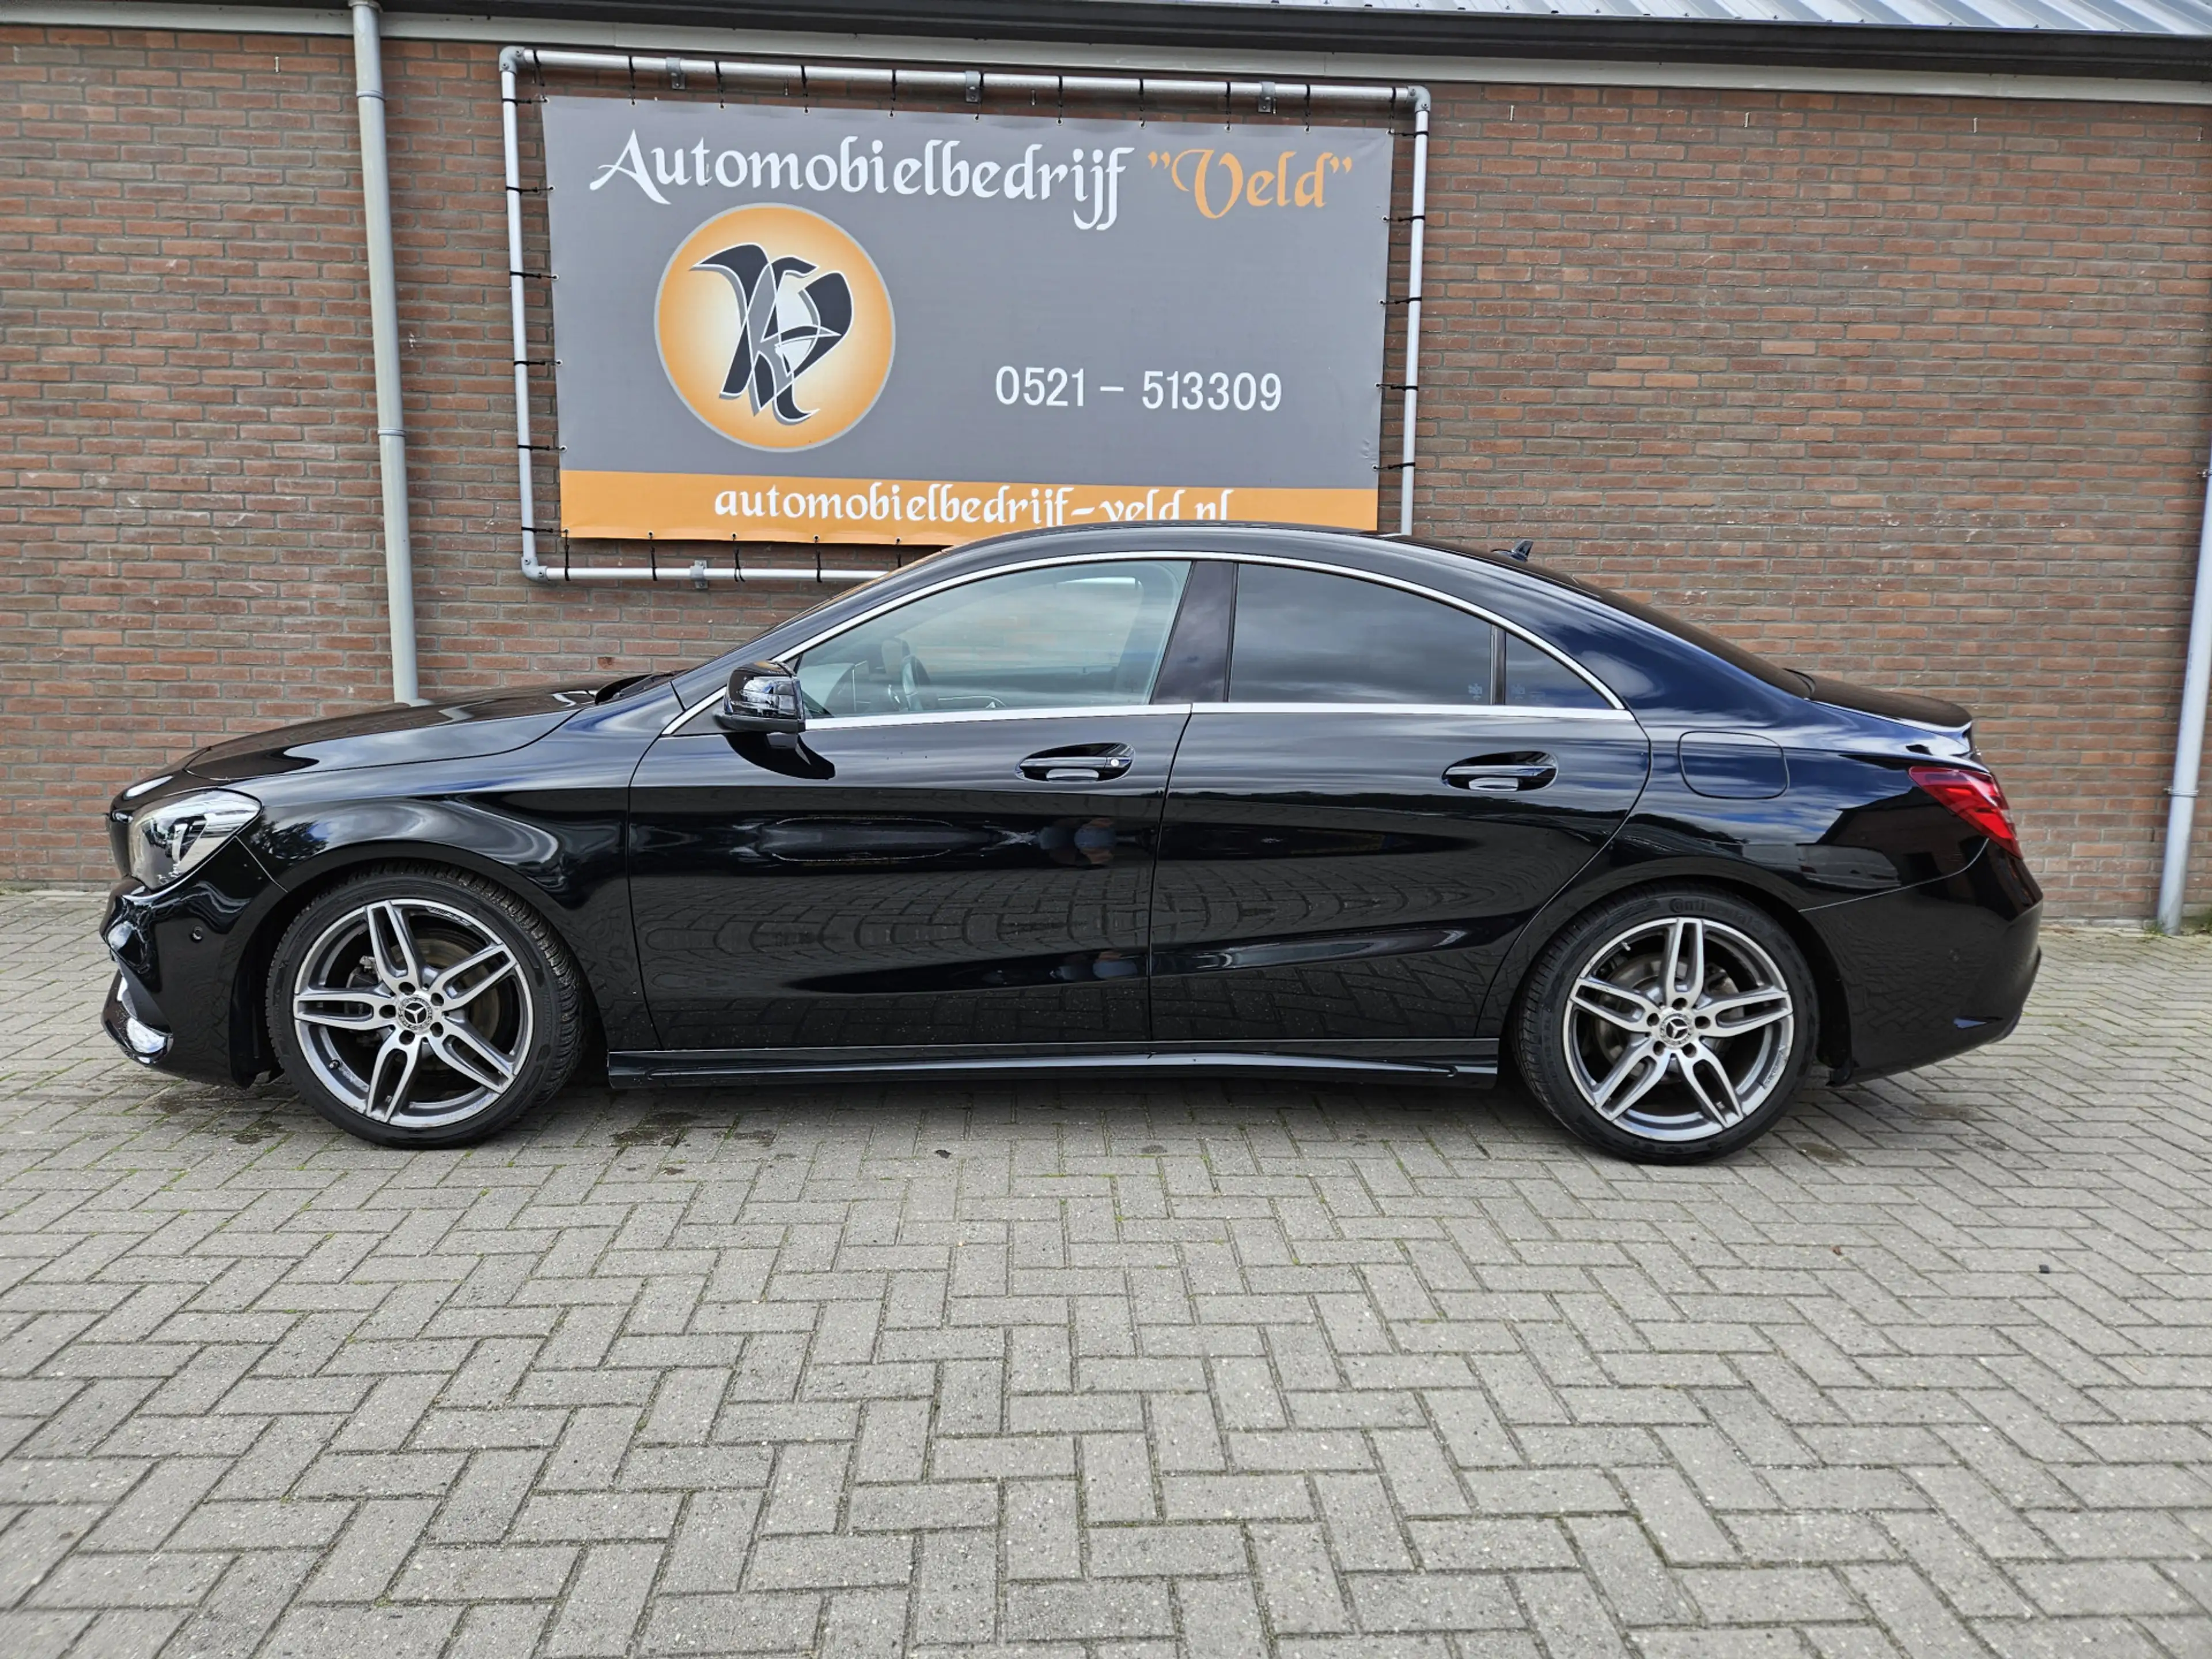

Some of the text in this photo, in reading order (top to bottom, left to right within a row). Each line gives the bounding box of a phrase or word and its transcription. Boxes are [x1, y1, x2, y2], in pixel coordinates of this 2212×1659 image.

[589, 128, 1135, 231] Automobielbedrijf
[995, 365, 1085, 407] 0521
[1141, 370, 1282, 412] 513309
[714, 481, 1234, 528] automobielbedrijf-veldnl
